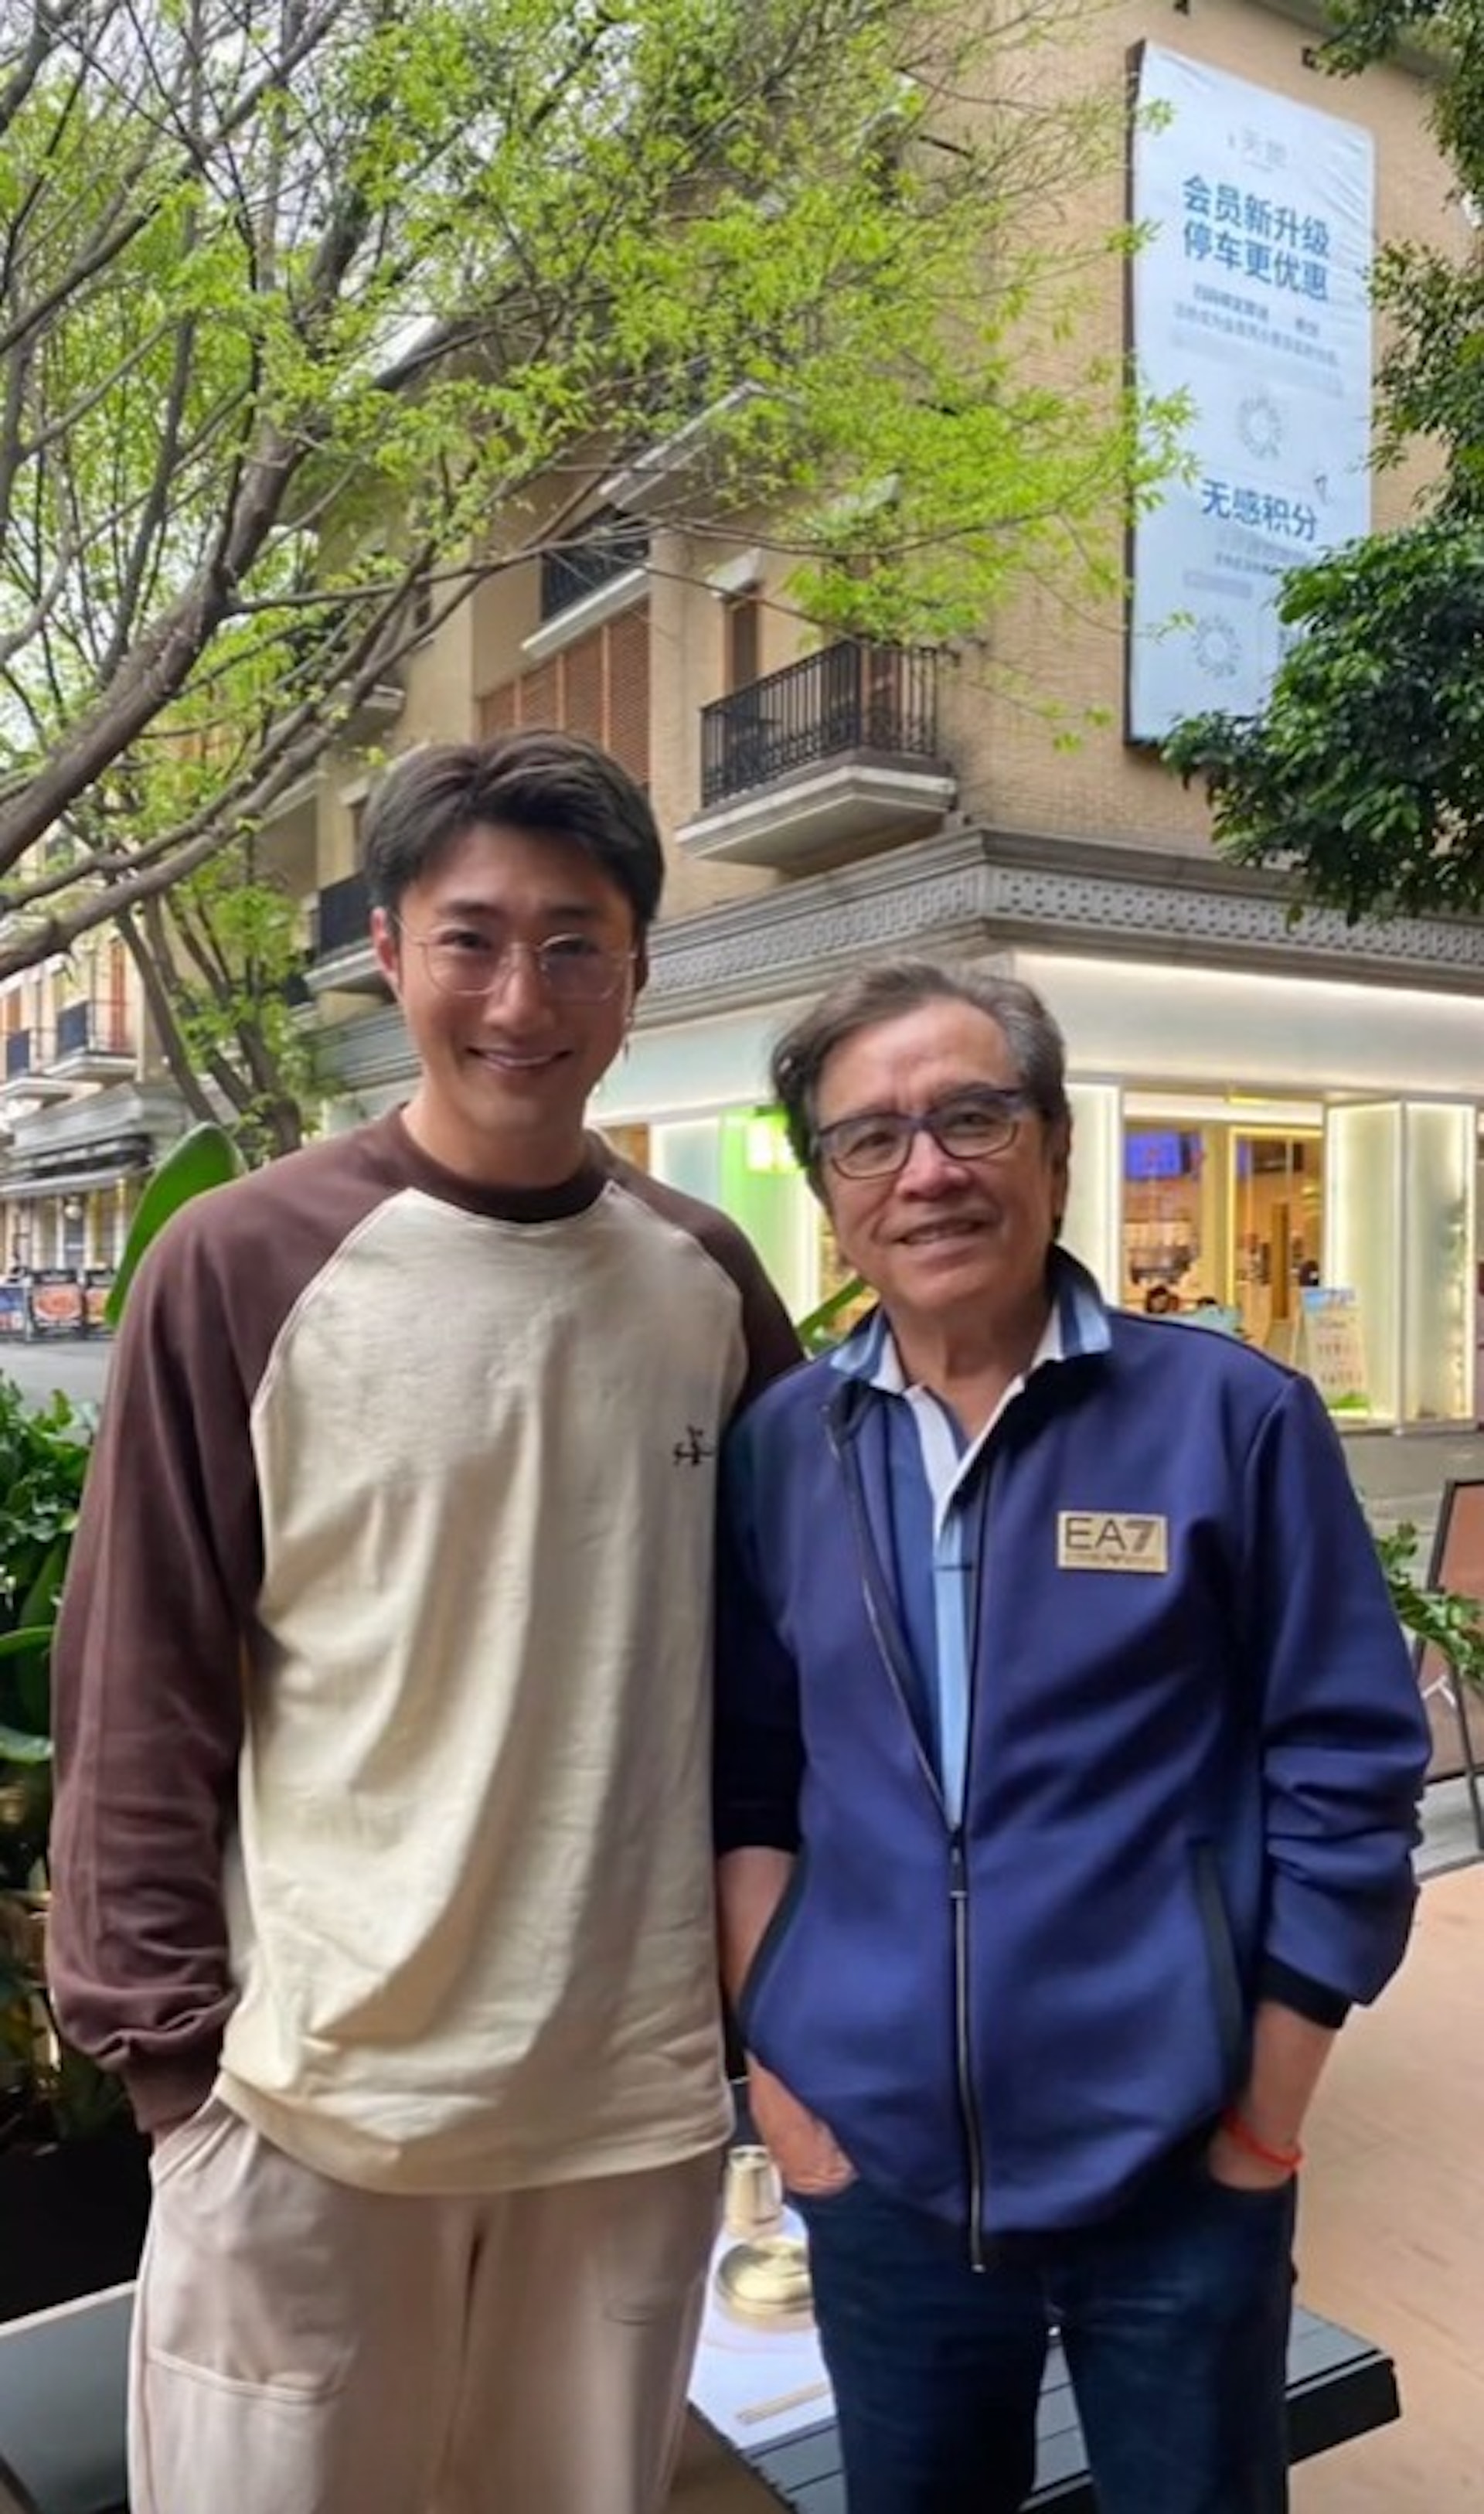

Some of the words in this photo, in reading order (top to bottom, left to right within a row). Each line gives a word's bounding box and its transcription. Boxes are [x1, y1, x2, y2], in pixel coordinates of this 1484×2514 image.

[1183, 174, 1330, 258] 会员新升级
[1183, 220, 1330, 301] 停车更优惠
[1201, 478, 1316, 541] 无感积分
[1065, 1516, 1156, 1553] EA7
